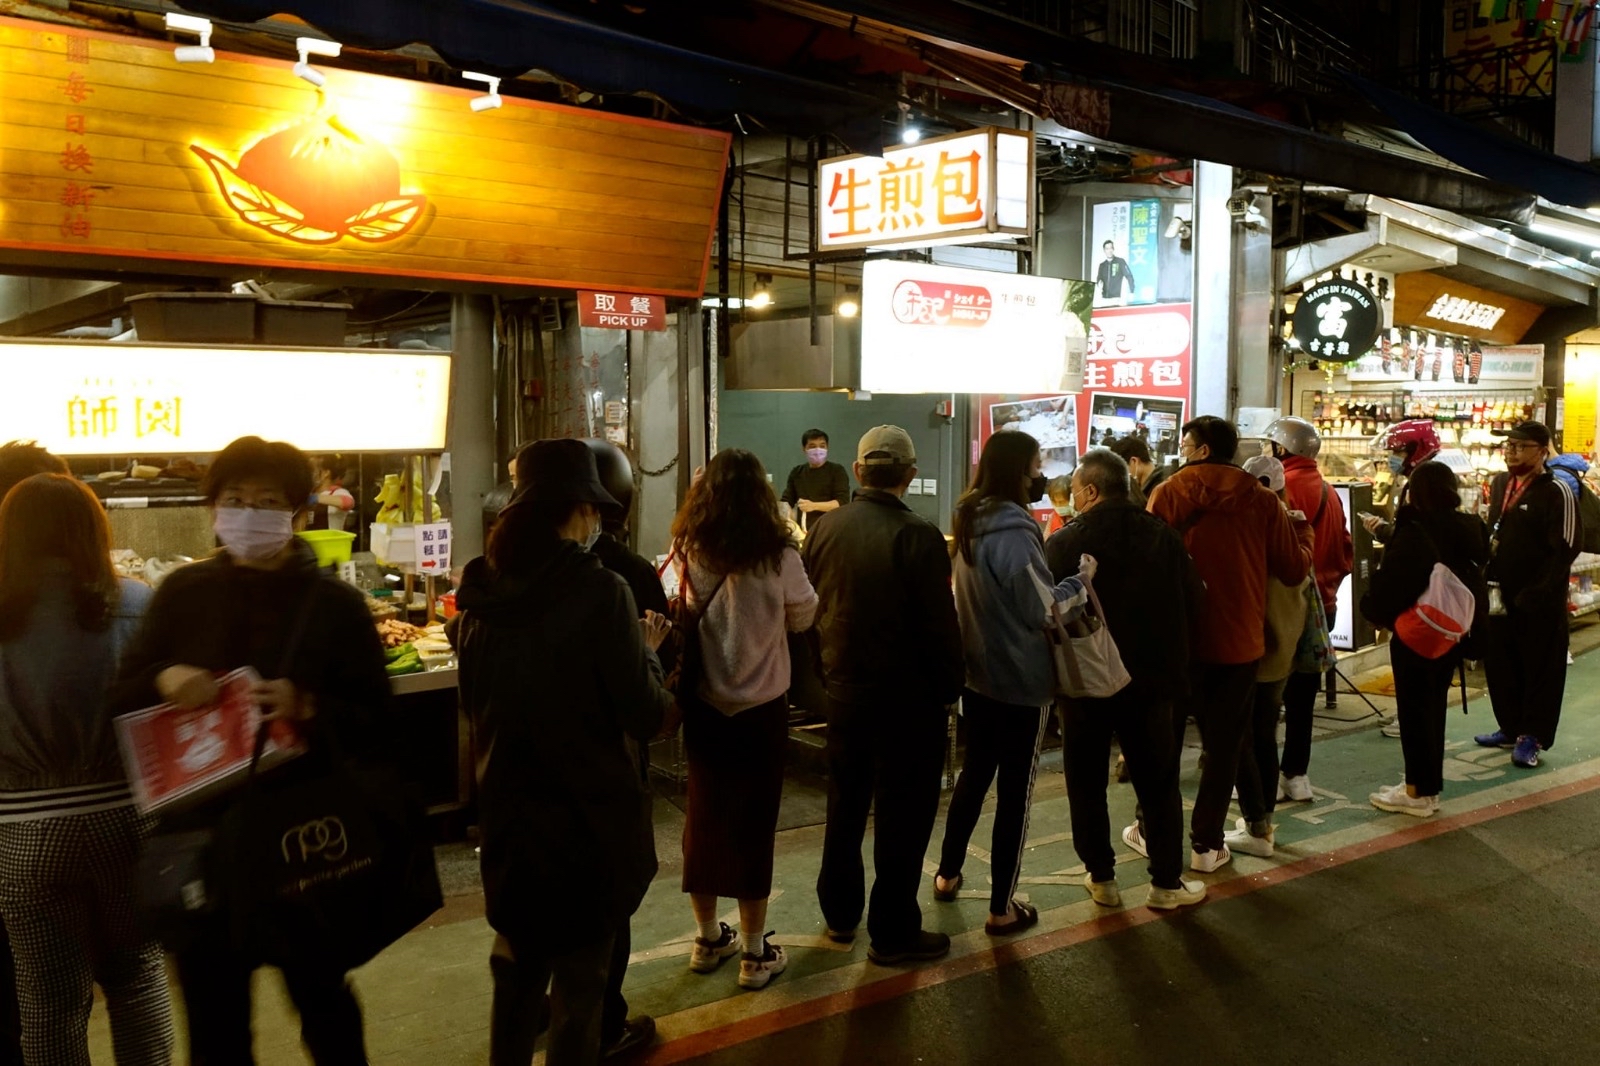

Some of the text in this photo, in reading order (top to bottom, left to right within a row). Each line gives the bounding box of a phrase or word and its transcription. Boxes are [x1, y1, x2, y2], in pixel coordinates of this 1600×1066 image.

[58, 71, 95, 240] 每日換新油
[828, 150, 984, 239] 生煎包
[594, 293, 651, 315] 取餐
[1305, 285, 1371, 309] MADE IN TAIWAN
[599, 315, 648, 327] PICK UP
[1083, 359, 1183, 388] 生煎包
